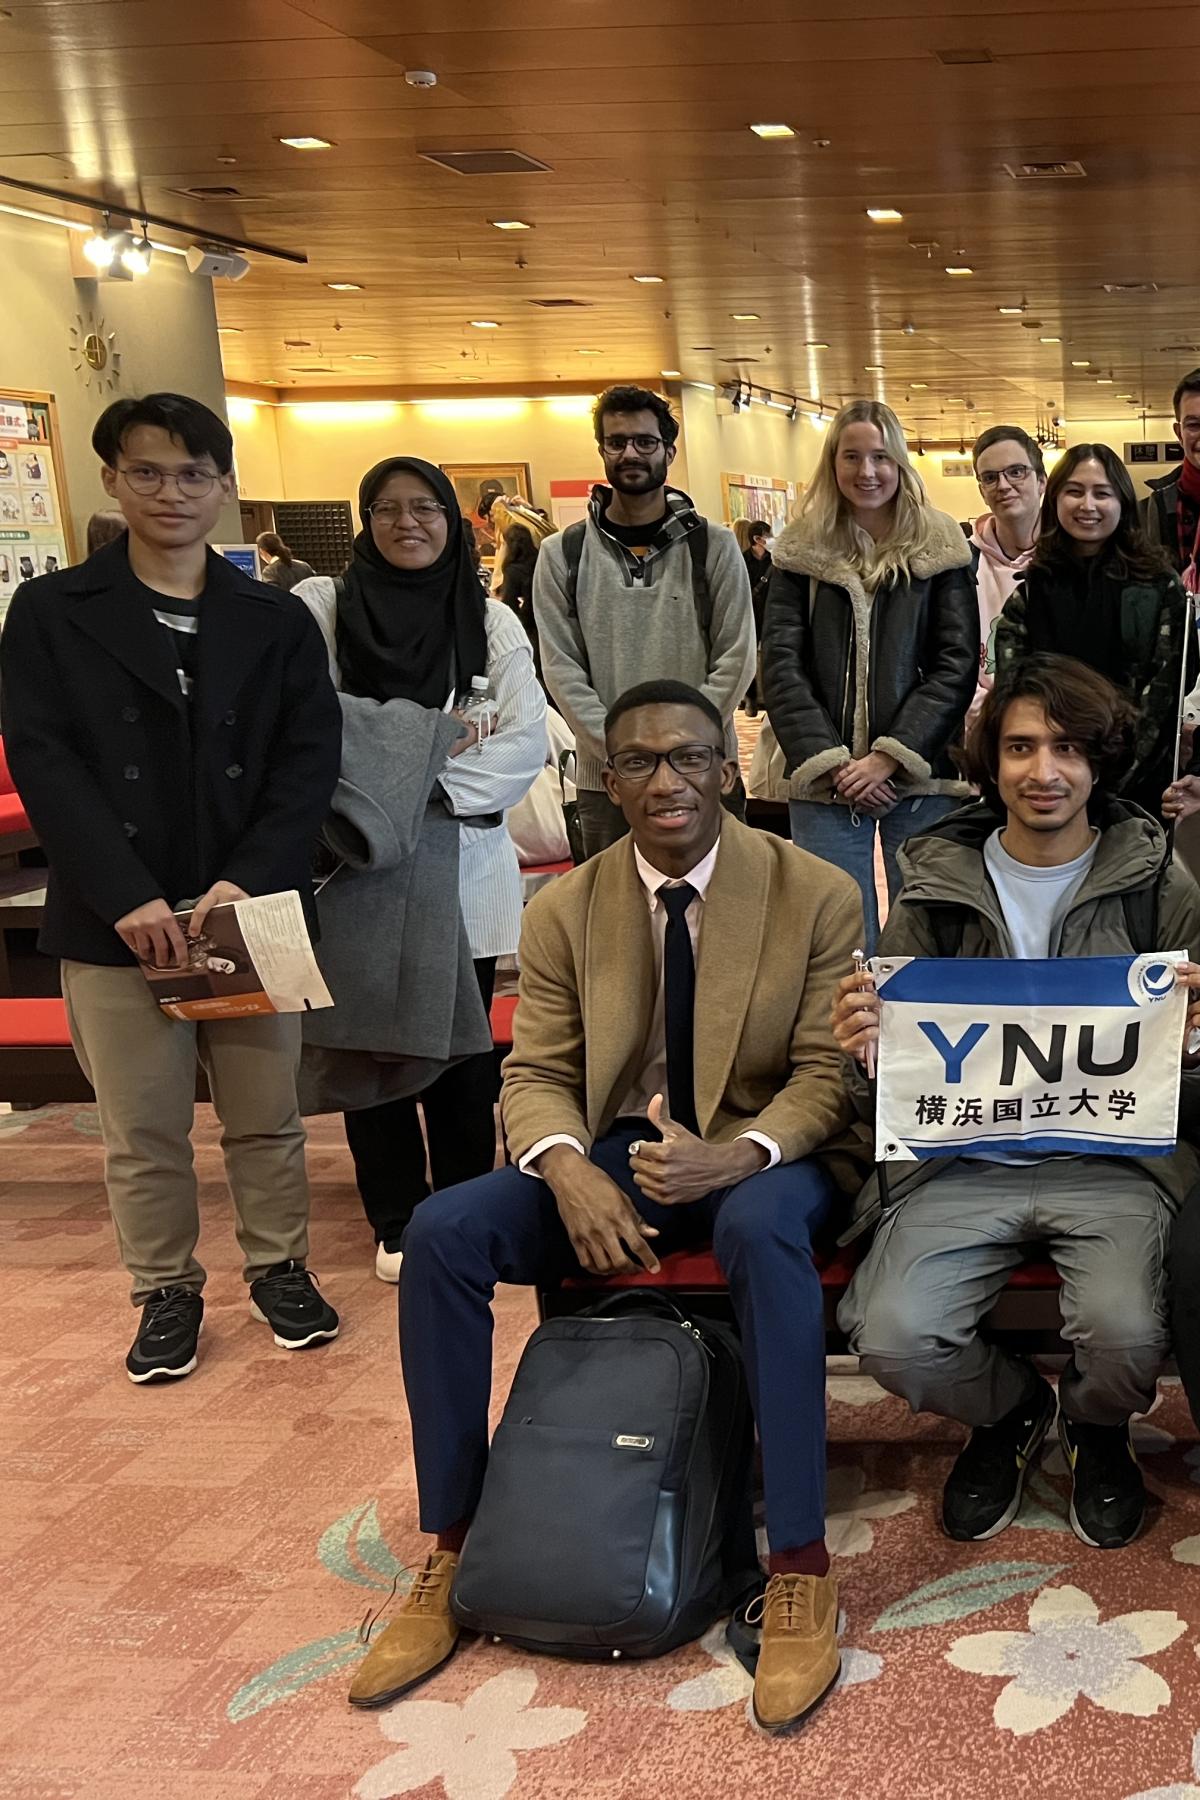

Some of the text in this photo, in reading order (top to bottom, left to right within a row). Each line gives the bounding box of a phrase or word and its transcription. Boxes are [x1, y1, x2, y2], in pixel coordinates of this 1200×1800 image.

[1148, 995, 1167, 1003] YNU
[917, 1021, 1141, 1086] YNU
[915, 1088, 1137, 1127] 横浜国立大学
